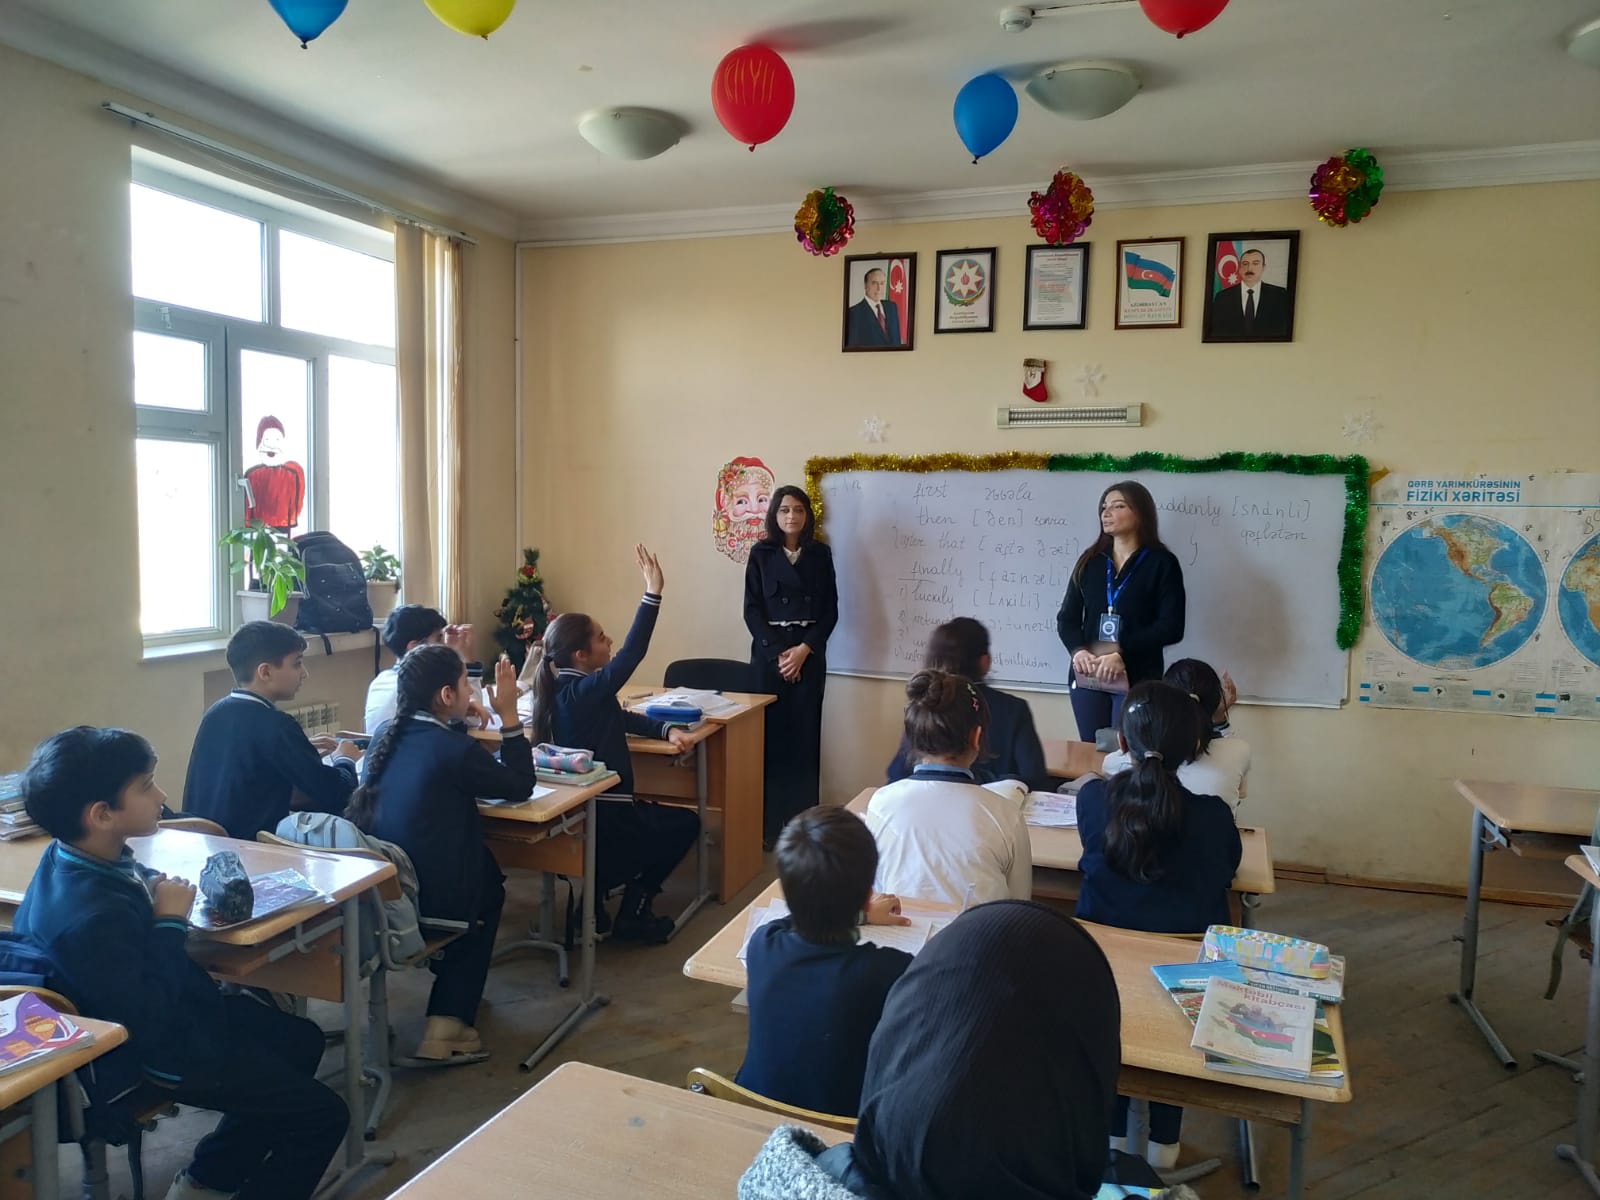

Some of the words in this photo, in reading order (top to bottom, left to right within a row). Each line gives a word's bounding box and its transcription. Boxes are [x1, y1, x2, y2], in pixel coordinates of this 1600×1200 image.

[912, 480, 950, 505] first
[1407, 479, 1434, 488] QƏRB
[1436, 478, 1521, 489] YARIMKÜRƏSİNİN
[1407, 489, 1448, 502] FİZİKİ
[1452, 489, 1521, 503] XƏRİTƏSİ
[914, 505, 960, 527] then
[1156, 496, 1223, 527] uddenly
[911, 556, 963, 588] finally
